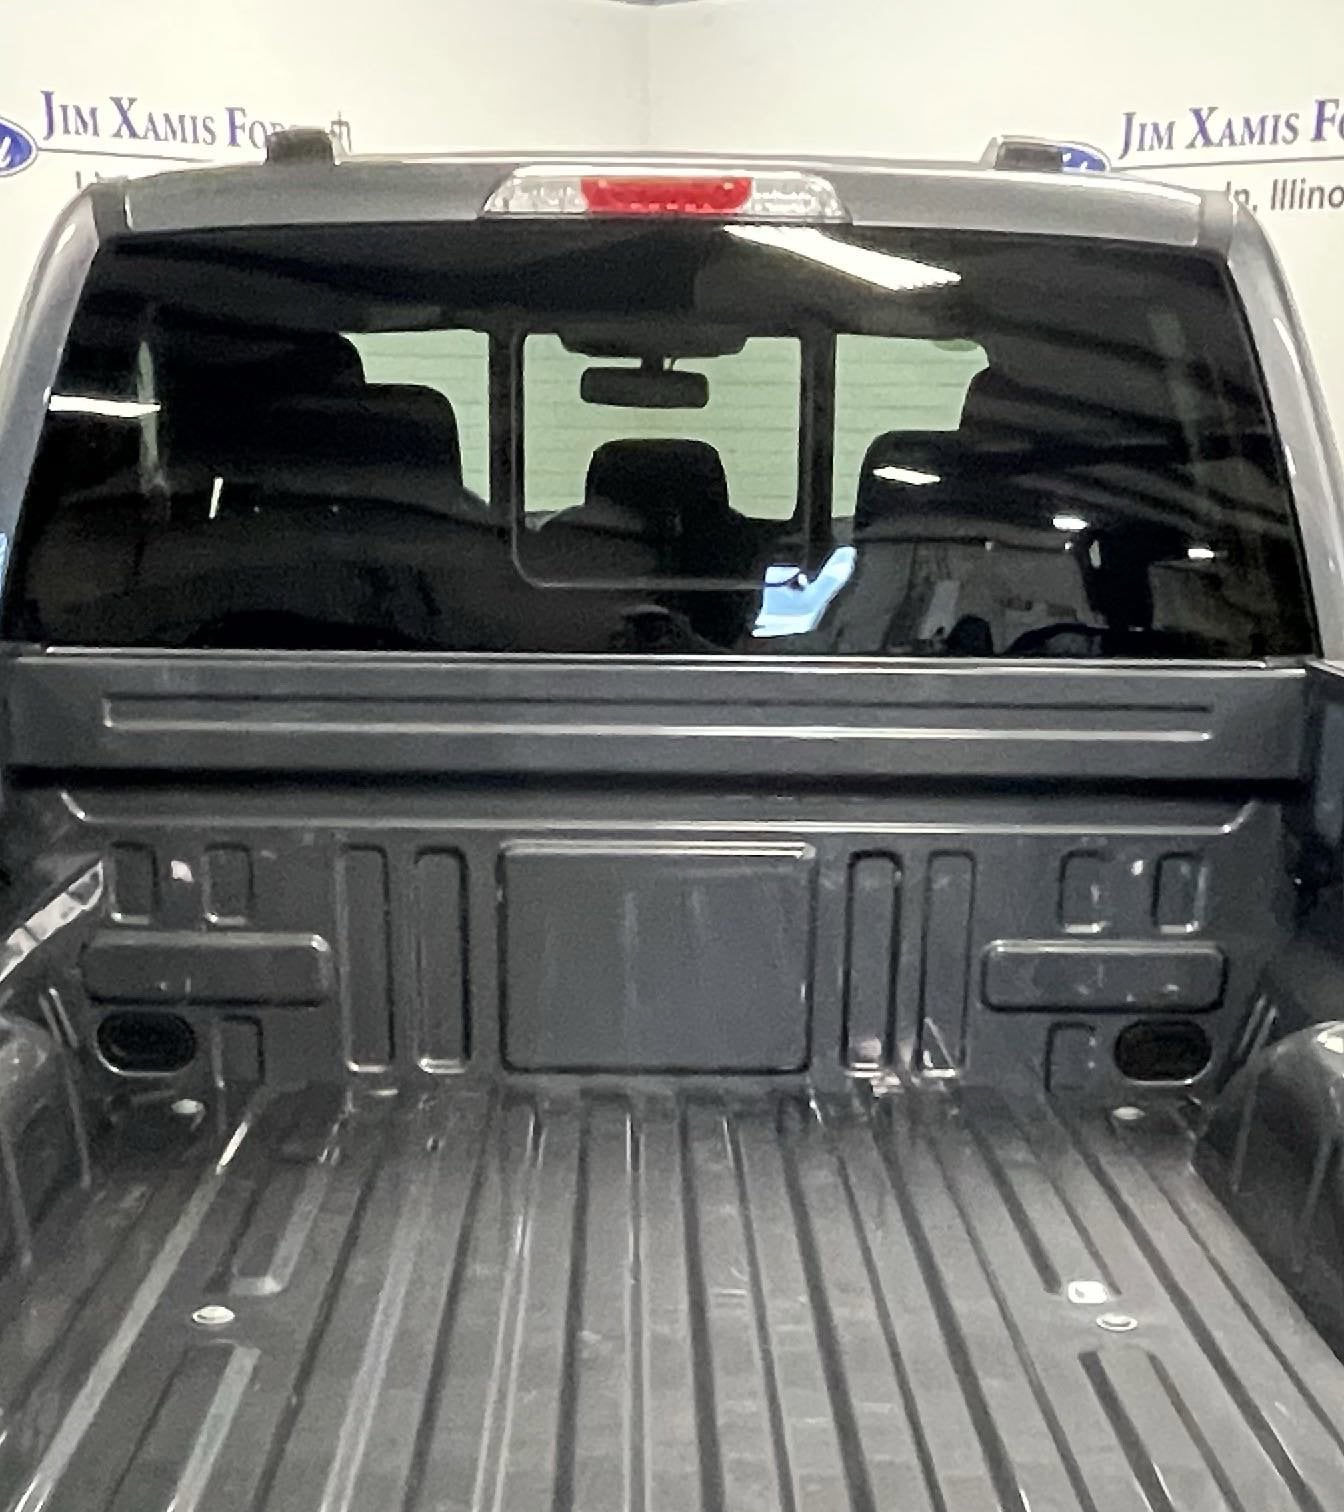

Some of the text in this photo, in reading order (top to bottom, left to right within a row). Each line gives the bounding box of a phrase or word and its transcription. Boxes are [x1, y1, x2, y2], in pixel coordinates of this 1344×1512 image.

[40, 90, 100, 141] JIM
[109, 96, 216, 145] XAMIS
[1118, 112, 1176, 159] JIM
[1185, 106, 1300, 149] XAMIS
